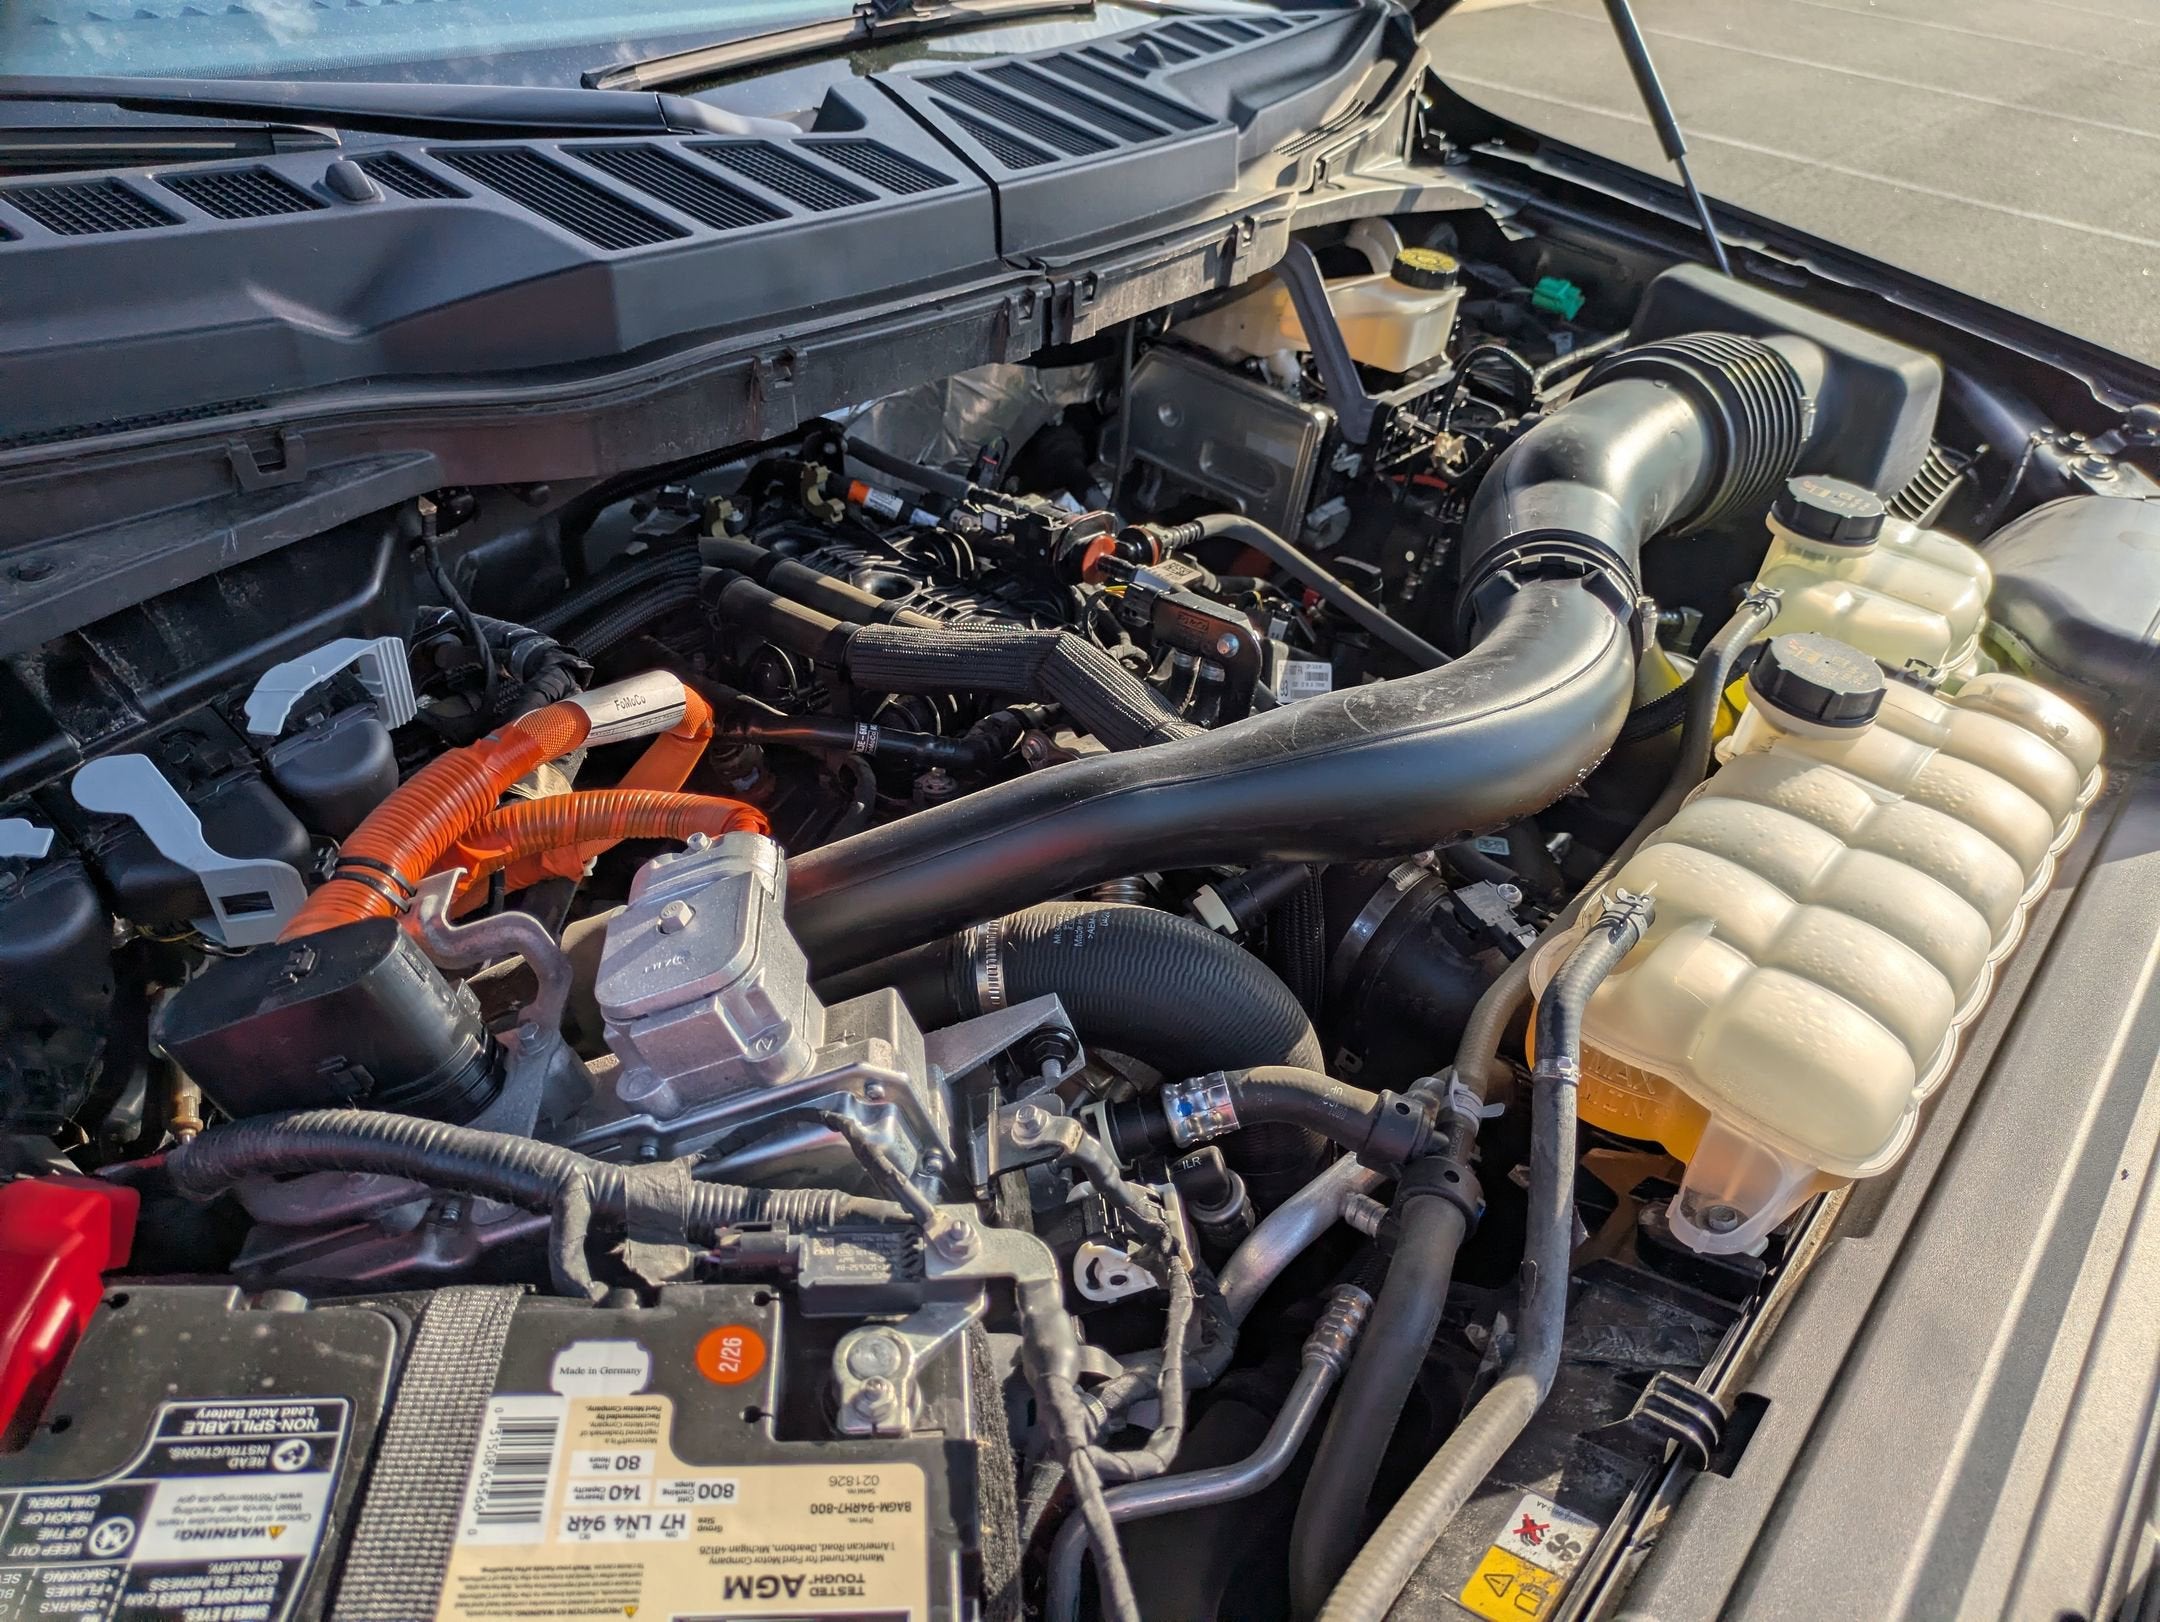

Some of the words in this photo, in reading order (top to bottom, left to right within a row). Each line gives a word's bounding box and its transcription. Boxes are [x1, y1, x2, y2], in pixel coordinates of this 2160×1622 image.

[614, 694, 647, 711] FoMoCo
[1182, 1156, 1202, 1170] ILR
[719, 1337, 743, 1373] 2/26
[600, 1367, 642, 1376] Germany
[195, 1407, 246, 1420] Battery
[248, 1407, 279, 1418] Acid
[281, 1406, 314, 1417] Lead
[181, 1417, 319, 1434] NON-SPILLABLE
[168, 1445, 271, 1459] INSTRUCTIONS.
[228, 1456, 268, 1468] READ
[615, 1455, 641, 1470] 80
[829, 1475, 880, 1486] 021826
[609, 1484, 641, 1500] 140
[698, 1484, 734, 1499] 800
[28, 1495, 100, 1509] CHILDREN.
[20, 1512, 43, 1524] OF
[44, 1511, 95, 1524] REACH
[566, 1515, 606, 1531] 94R
[613, 1515, 652, 1530] LN4
[660, 1514, 686, 1529] H7
[698, 1517, 715, 1525] Size
[36, 1528, 65, 1540] THE
[65, 1527, 88, 1539] OF
[174, 1526, 268, 1541] WARNING:
[8, 1544, 40, 1556] OUT
[41, 1542, 82, 1556] KEEP
[699, 1546, 726, 1555] 48126
[728, 1544, 769, 1554] Michigan
[772, 1543, 816, 1552] Dearborn,
[819, 1542, 845, 1552] Road,
[847, 1542, 890, 1551] American
[709, 1555, 752, 1565] Company
[753, 1555, 781, 1565] Motor
[782, 1555, 803, 1564] Ford
[805, 1555, 817, 1564] for
[820, 1554, 885, 1563] Manufactured
[42, 1568, 110, 1582] SMOKING
[230, 1573, 279, 1586] CAUSE
[149, 1575, 229, 1590] BLINDNESS
[723, 1574, 806, 1600] AGM
[45, 1583, 104, 1597] FLAMES
[159, 1590, 203, 1603] GASES
[204, 1587, 275, 1601] EXPLOSIVE
[809, 1586, 865, 1597] TESTED
[39, 1598, 97, 1613] SPARKS
[124, 1592, 157, 1606] CAN
